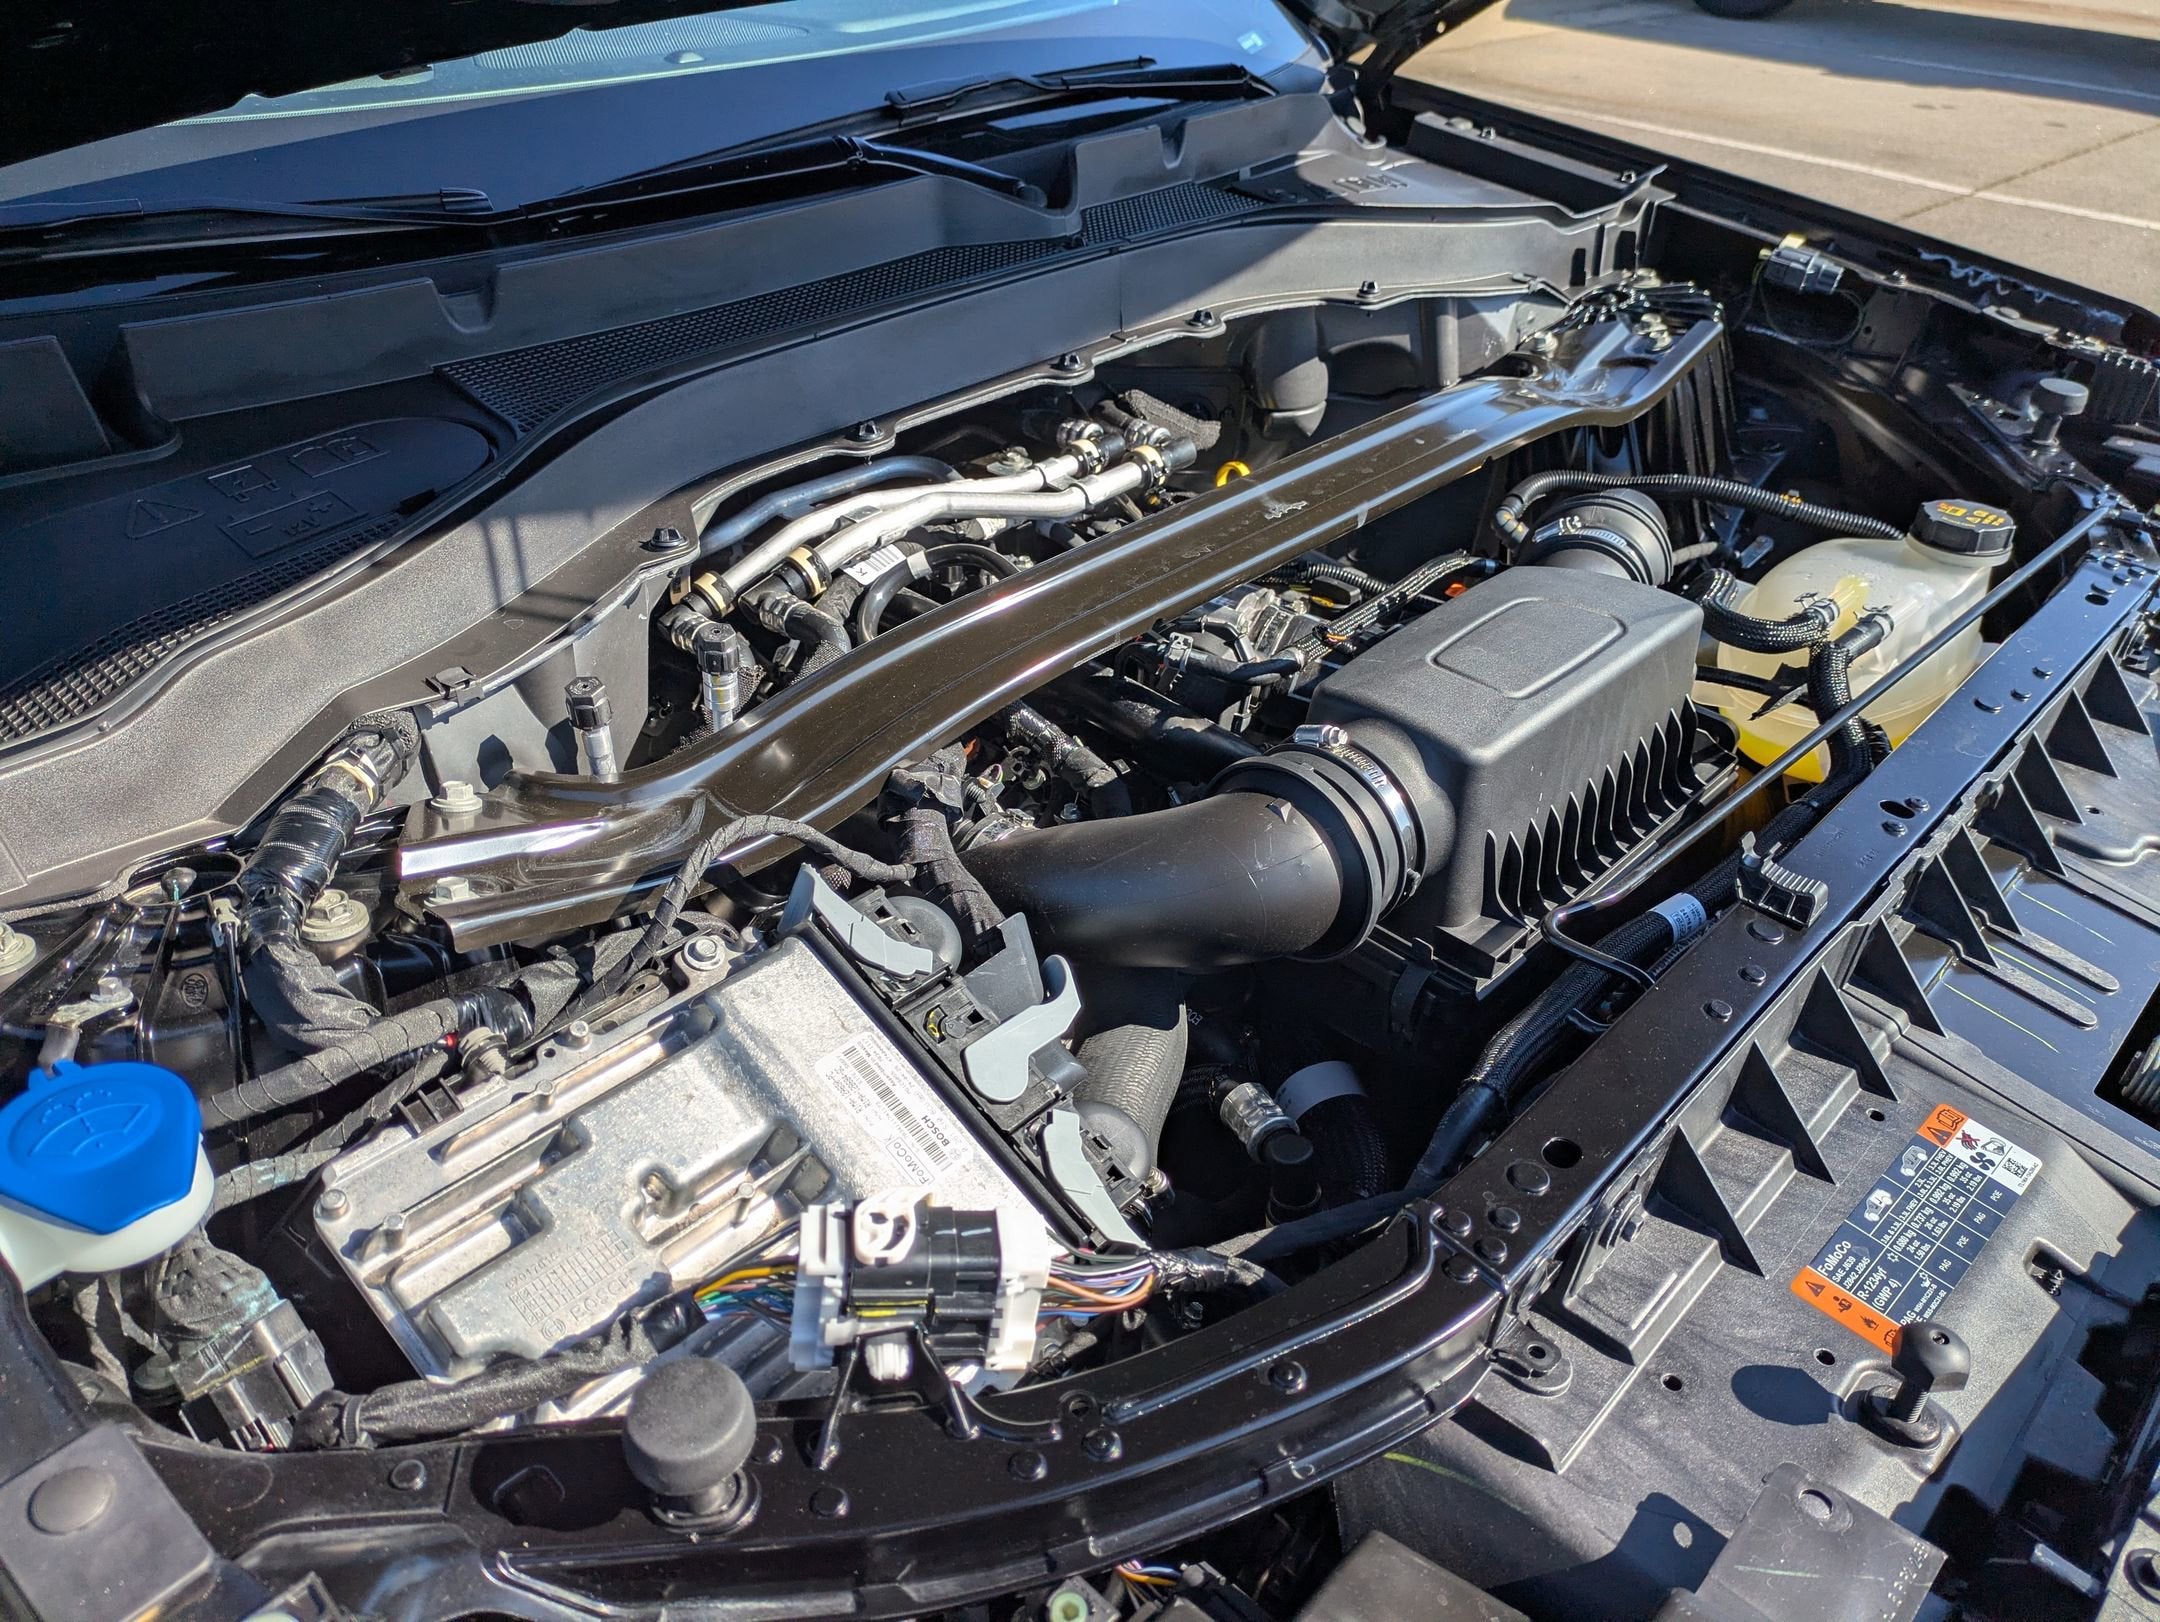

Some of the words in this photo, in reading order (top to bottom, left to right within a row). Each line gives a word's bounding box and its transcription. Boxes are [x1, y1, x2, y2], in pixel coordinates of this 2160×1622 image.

[920, 1114, 950, 1147] BOSCH
[890, 1140, 930, 1185] FoMoCo
[1945, 1166, 1962, 1182] 0.992
[1955, 1160, 1969, 1171] kg
[1959, 1175, 1968, 1183] 35
[1965, 1179, 1978, 1191] 2.19
[1972, 1173, 1983, 1182] lbs
[1928, 1187, 1945, 1204] 0.992
[1938, 1181, 1952, 1192] kg
[1941, 1196, 1951, 1205] 35
[1989, 1189, 2003, 1202] POE
[1948, 1201, 1961, 1213] 2.19
[1955, 1194, 1966, 1204] lbs
[1910, 1212, 1927, 1229] 0.737
[1920, 1205, 1934, 1217] kg
[1923, 1221, 1933, 1230] 26
[1929, 1216, 1938, 1224] oz
[1937, 1219, 1948, 1229] lbs
[1972, 1211, 1986, 1224] PAG
[1892, 1234, 1909, 1252] 0.680
[1902, 1227, 1917, 1239] kg
[1905, 1244, 1916, 1253] 24
[1911, 1239, 1920, 1247] oz
[1919, 1241, 1931, 1252] lbs
[1955, 1234, 1969, 1248] POE
[1816, 1237, 1852, 1276] FoMoCo
[1937, 1258, 1952, 1272] PAG
[1831, 1267, 1846, 1282] SAE
[1840, 1255, 1856, 1270] J639
[1841, 1271, 1859, 1289] J2842
[1853, 1256, 1870, 1274] J2845
[1855, 1265, 1890, 1302] R-1234yf
[1870, 1284, 1897, 1311] (GWP
[1885, 1277, 1903, 1291] 4)
[1899, 1309, 1917, 1327] PAG
